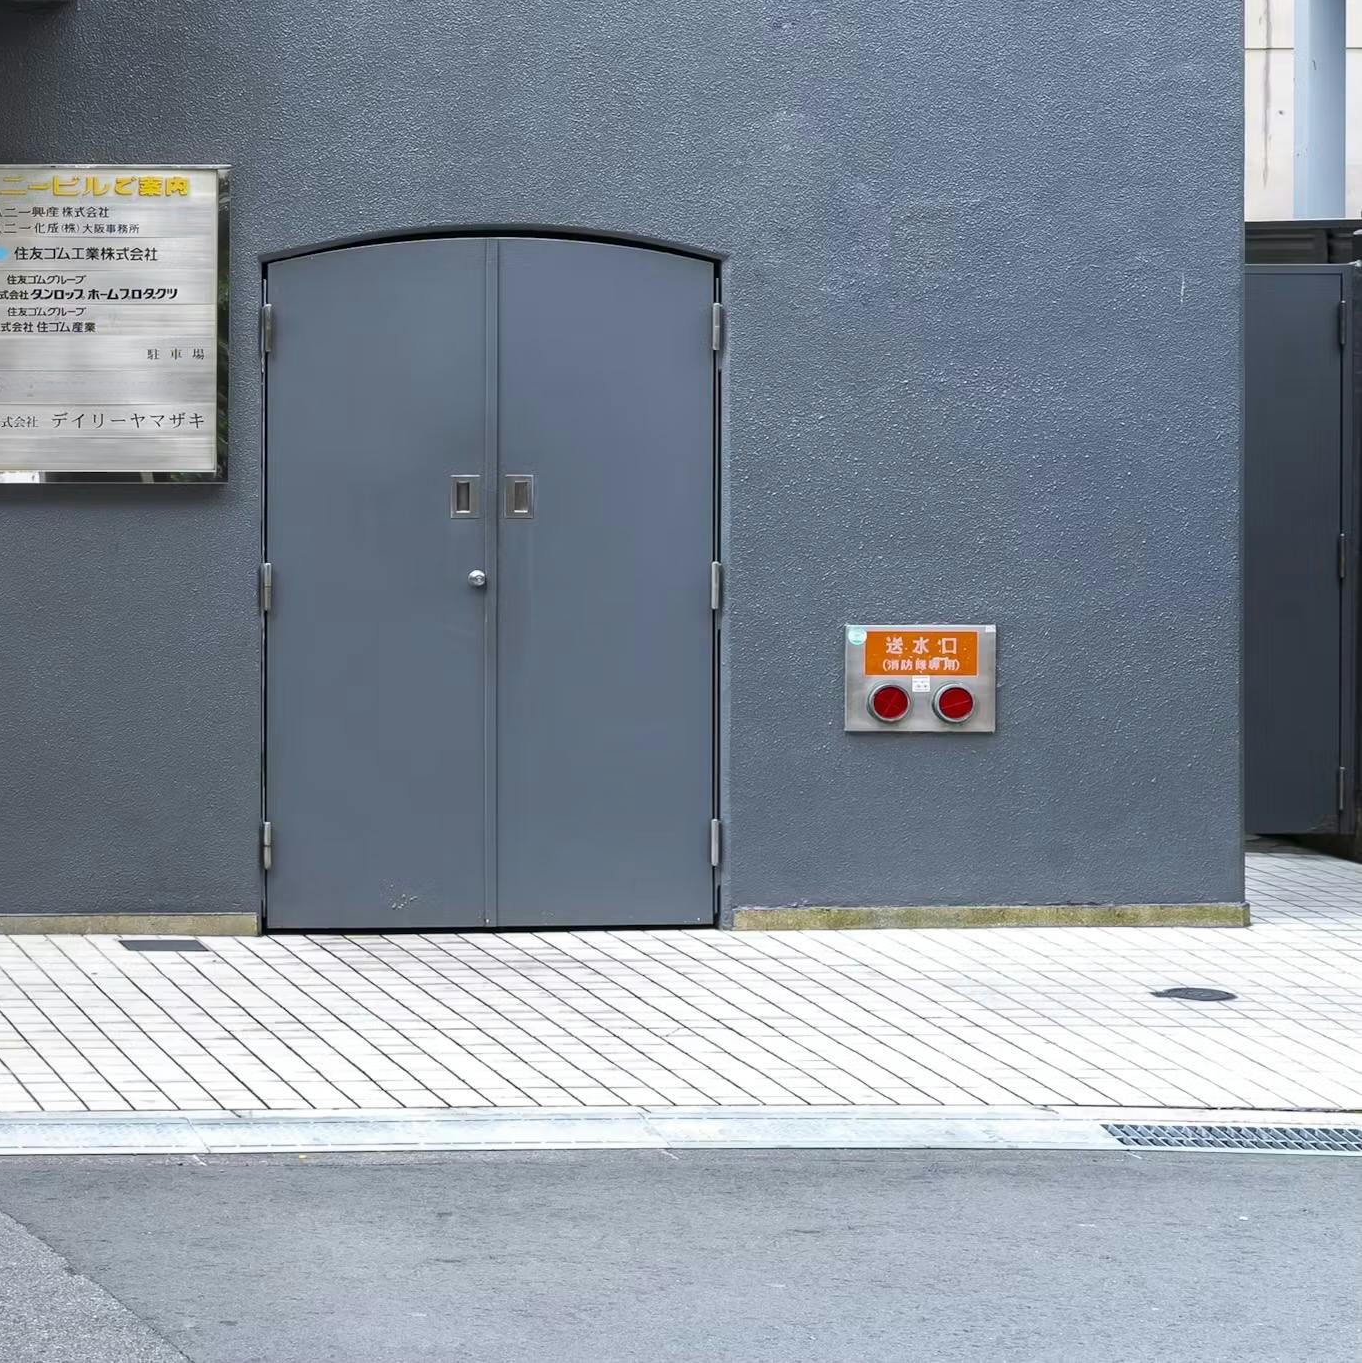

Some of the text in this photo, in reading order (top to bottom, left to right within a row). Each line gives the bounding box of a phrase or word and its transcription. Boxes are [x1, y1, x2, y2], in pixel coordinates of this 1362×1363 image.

[13, 246, 159, 262] 住友ゴム工業株式会社
[6, 274, 88, 285] 住友ゴムグループ
[6, 306, 88, 317] 住友ゴムグループ
[51, 412, 205, 430] デイリーヤマザキ
[885, 636, 958, 655] 送水口
